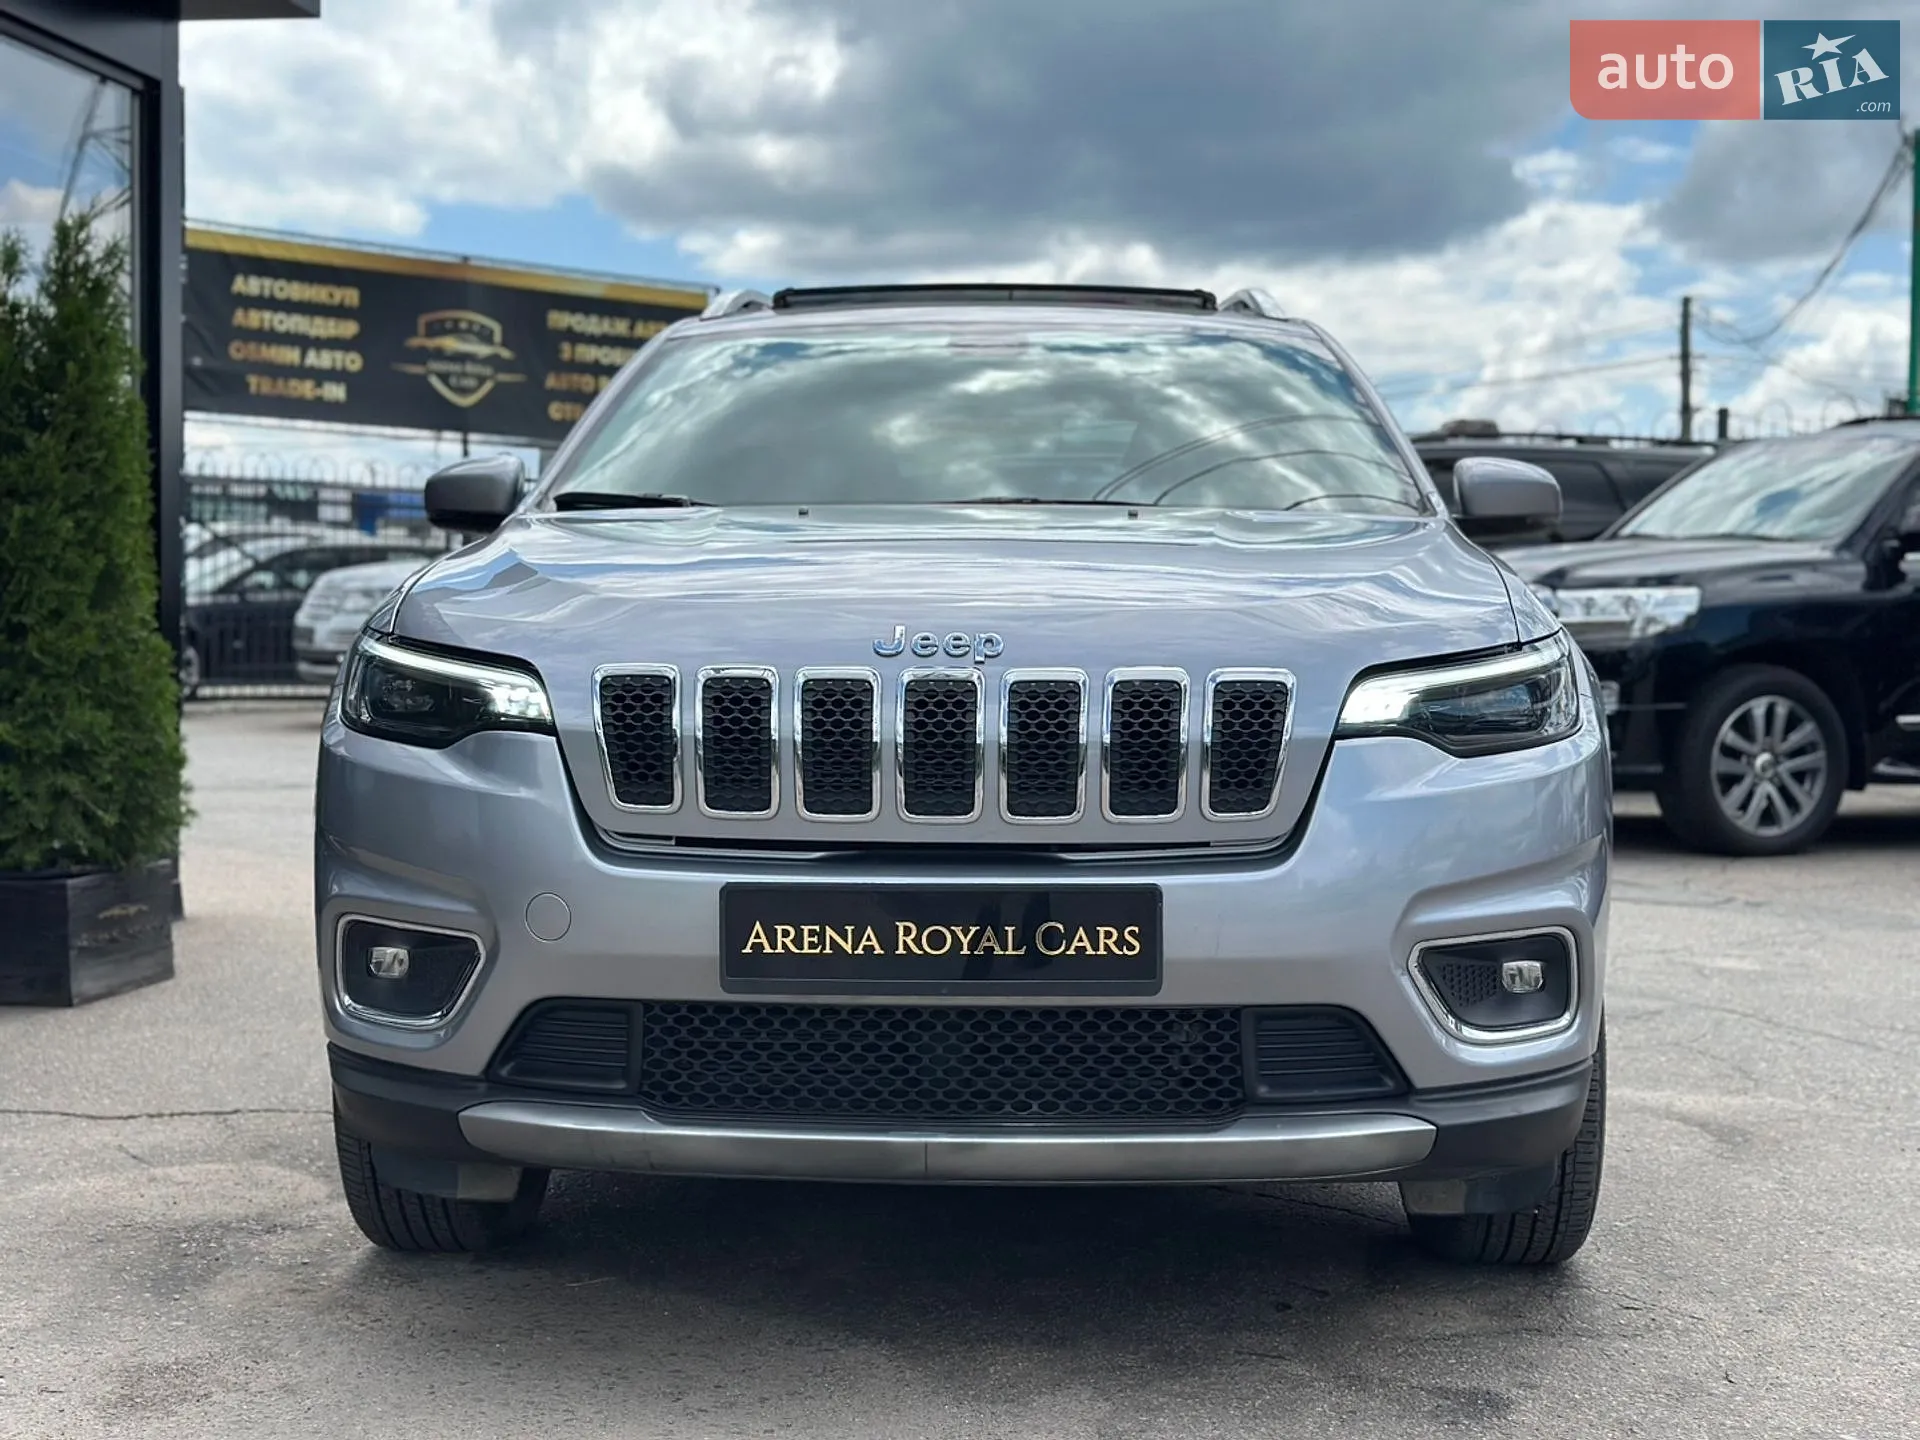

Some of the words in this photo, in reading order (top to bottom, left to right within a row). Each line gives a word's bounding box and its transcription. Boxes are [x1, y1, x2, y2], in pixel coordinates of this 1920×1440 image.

[230, 272, 360, 308] АВТОВИКУП
[547, 309, 631, 338] ПРОДАЖ
[303, 347, 364, 373] АВТО
[245, 373, 348, 404] TRADE-IN
[872, 624, 1005, 664] Jeep
[741, 920, 884, 955] ARENA
[894, 921, 1026, 955] ROYAL
[1035, 920, 1141, 956] CARS
